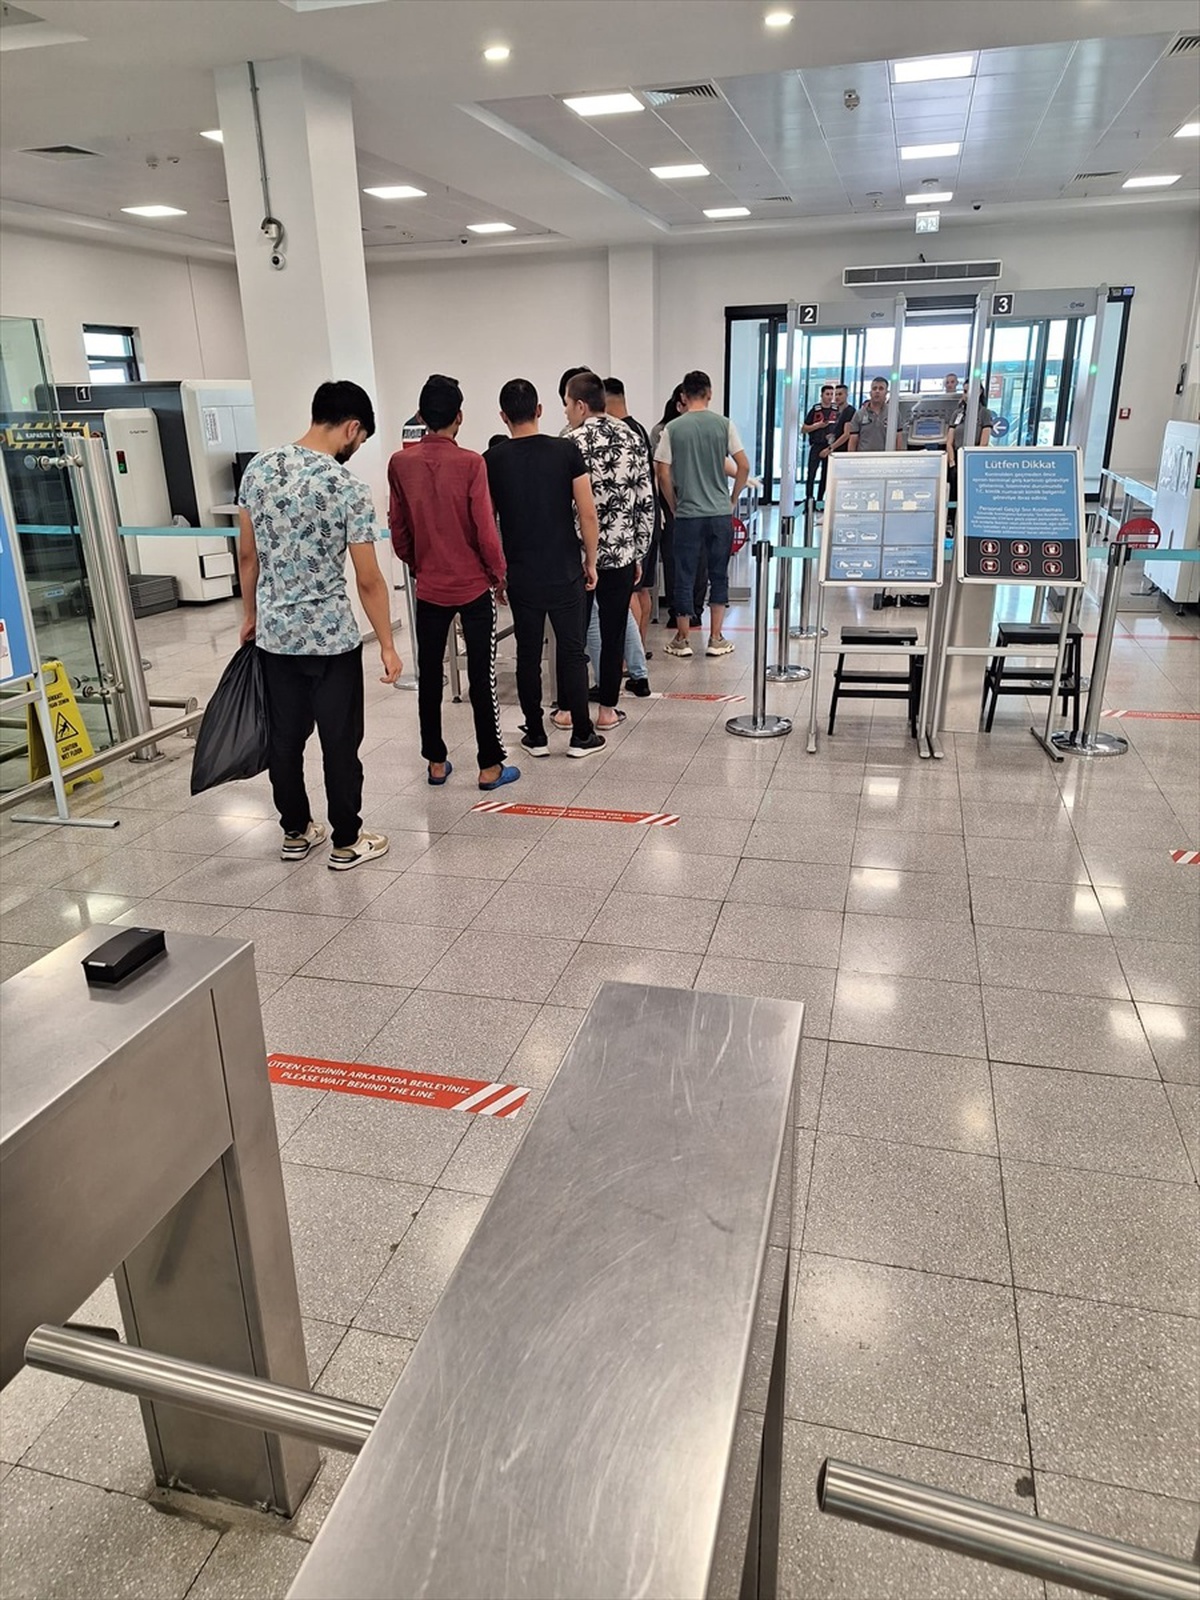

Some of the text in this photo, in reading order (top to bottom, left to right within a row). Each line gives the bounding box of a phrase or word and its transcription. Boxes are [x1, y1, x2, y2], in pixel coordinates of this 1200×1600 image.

[998, 298, 1009, 312] 3
[803, 307, 814, 322] 2
[79, 388, 87, 399] 1
[984, 459, 1057, 469] Lütfen Dikkat
[267, 1059, 471, 1096] ÜTFEN ÇİZGİNİN ARKASINDA BEKLEYİNİZ.
[280, 1071, 436, 1100] PLEASE WAIT BEHIND THE LINE.
